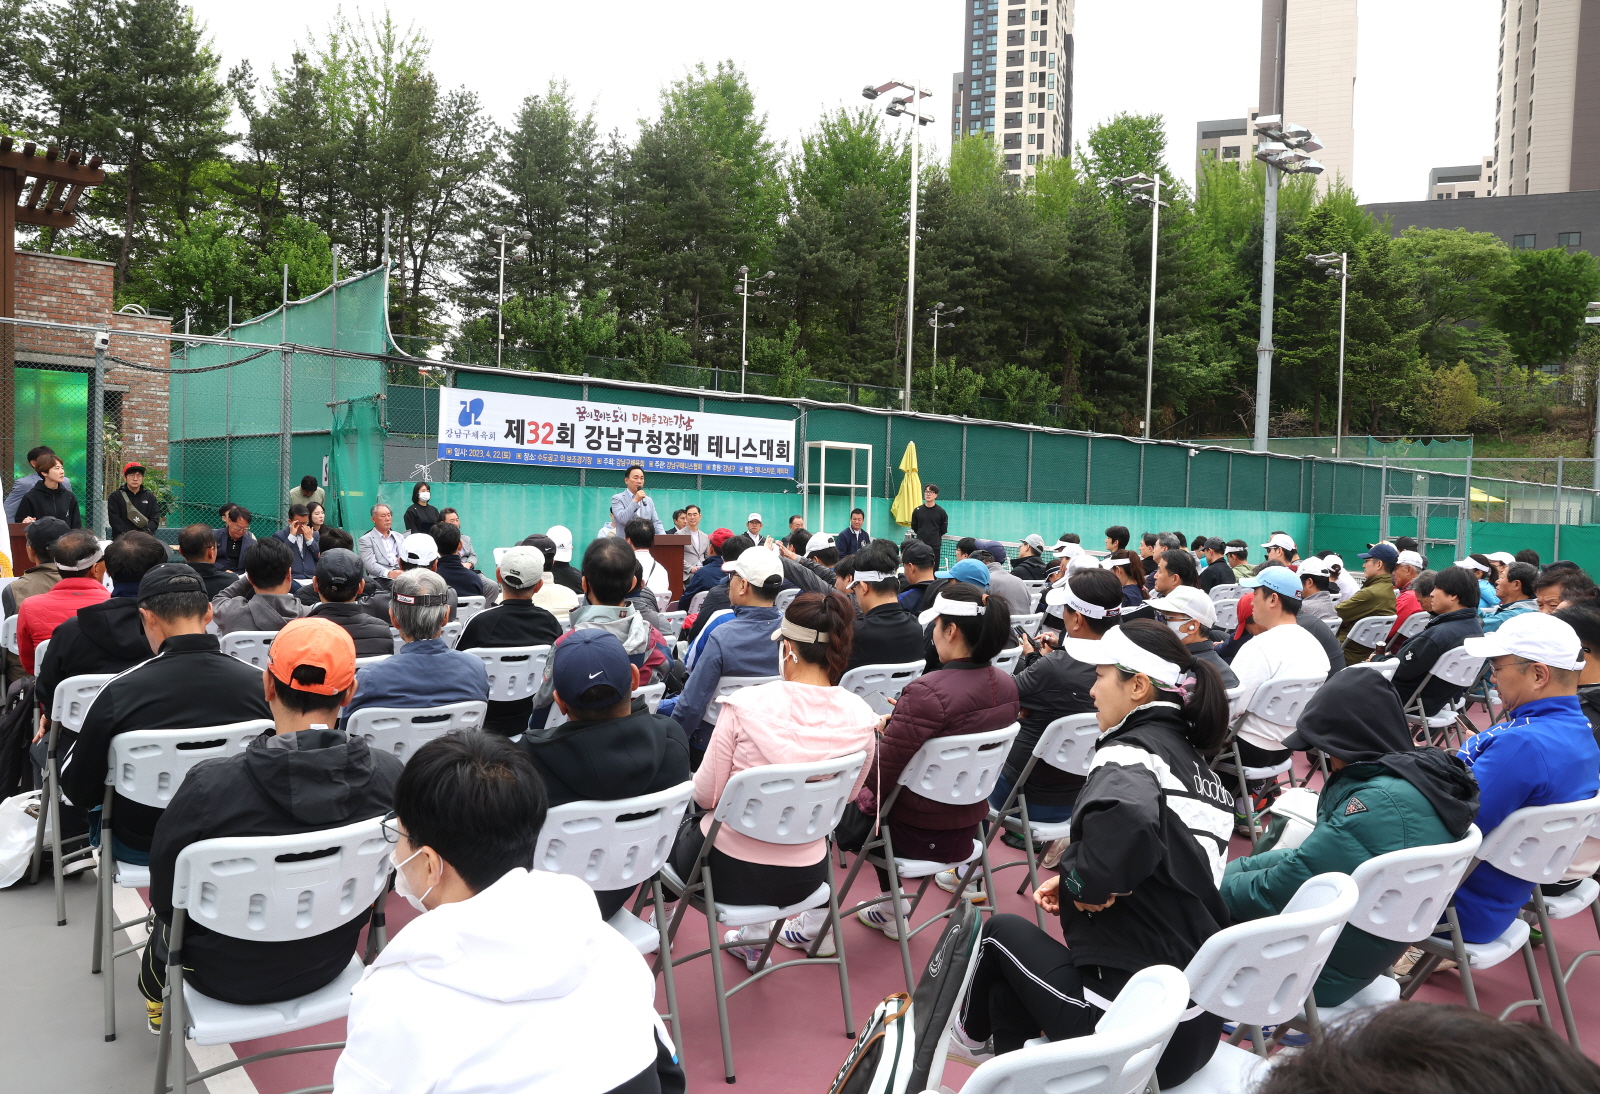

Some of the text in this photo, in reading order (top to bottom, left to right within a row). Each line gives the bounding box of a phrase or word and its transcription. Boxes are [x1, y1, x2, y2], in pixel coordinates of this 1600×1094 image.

[445, 429, 496, 441] 강남구체육회
[504, 419, 790, 462] 제32회 강남구청장배 테니스대회
[454, 447, 468, 457] 일시:
[523, 452, 537, 461] 장소:
